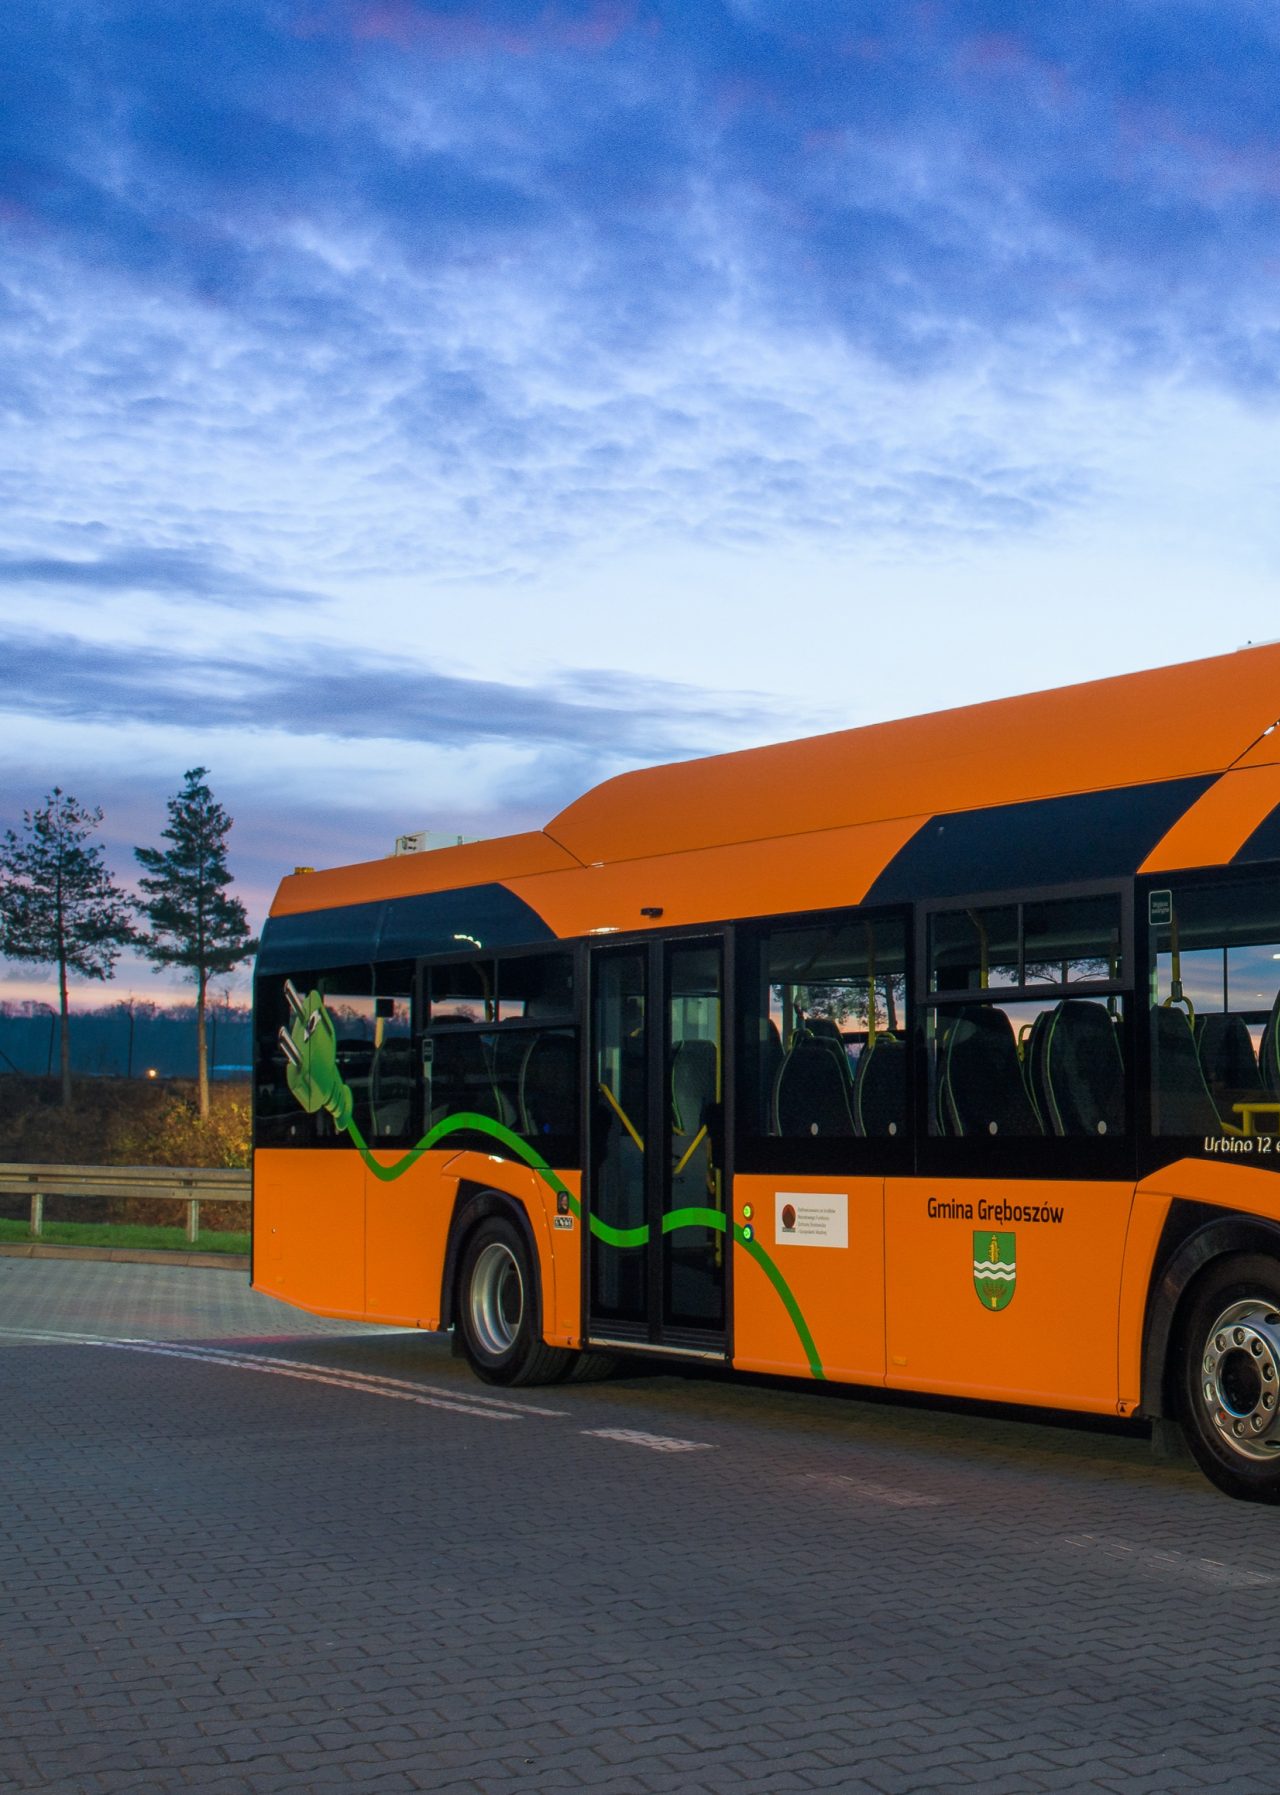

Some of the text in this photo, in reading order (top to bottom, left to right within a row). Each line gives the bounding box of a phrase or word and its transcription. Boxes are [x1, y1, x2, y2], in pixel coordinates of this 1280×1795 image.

[1204, 1136, 1253, 1153] Urbino
[1256, 1136, 1272, 1153] 12
[927, 1197, 1065, 1226] Gmina Gręboszów
